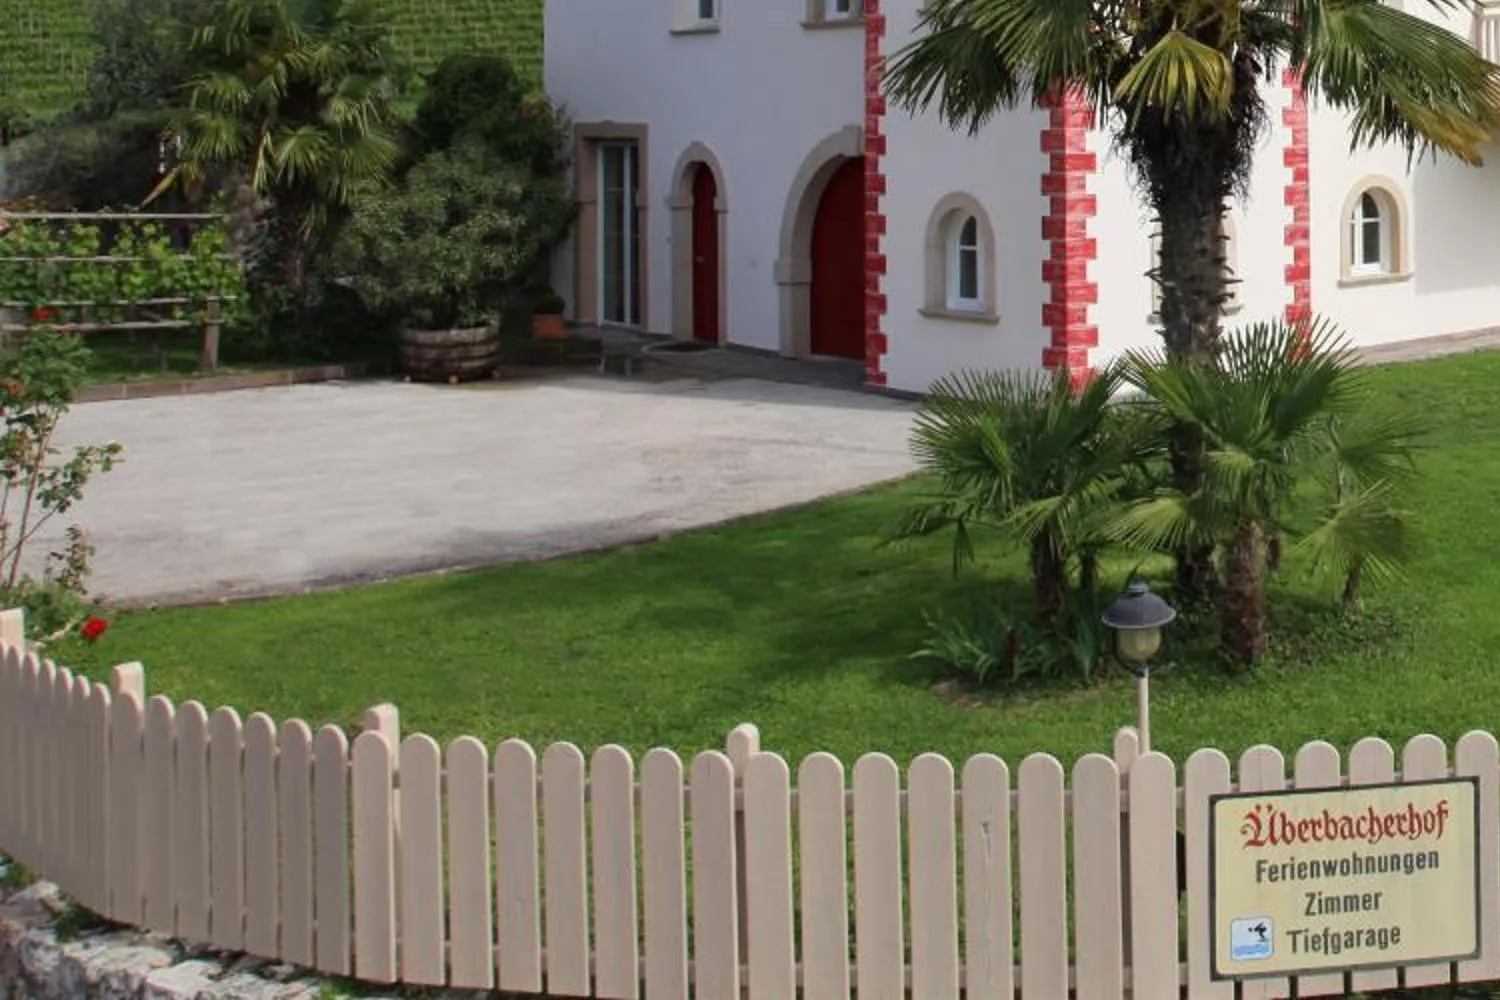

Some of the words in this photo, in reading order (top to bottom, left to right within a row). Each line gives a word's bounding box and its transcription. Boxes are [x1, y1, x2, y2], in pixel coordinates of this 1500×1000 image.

[1240, 800, 1449, 849] Überbacherhof
[1255, 850, 1440, 883] Ferienwohnungen
[1304, 891, 1383, 916] Zimmer
[1286, 925, 1401, 955] Tiefgarage
